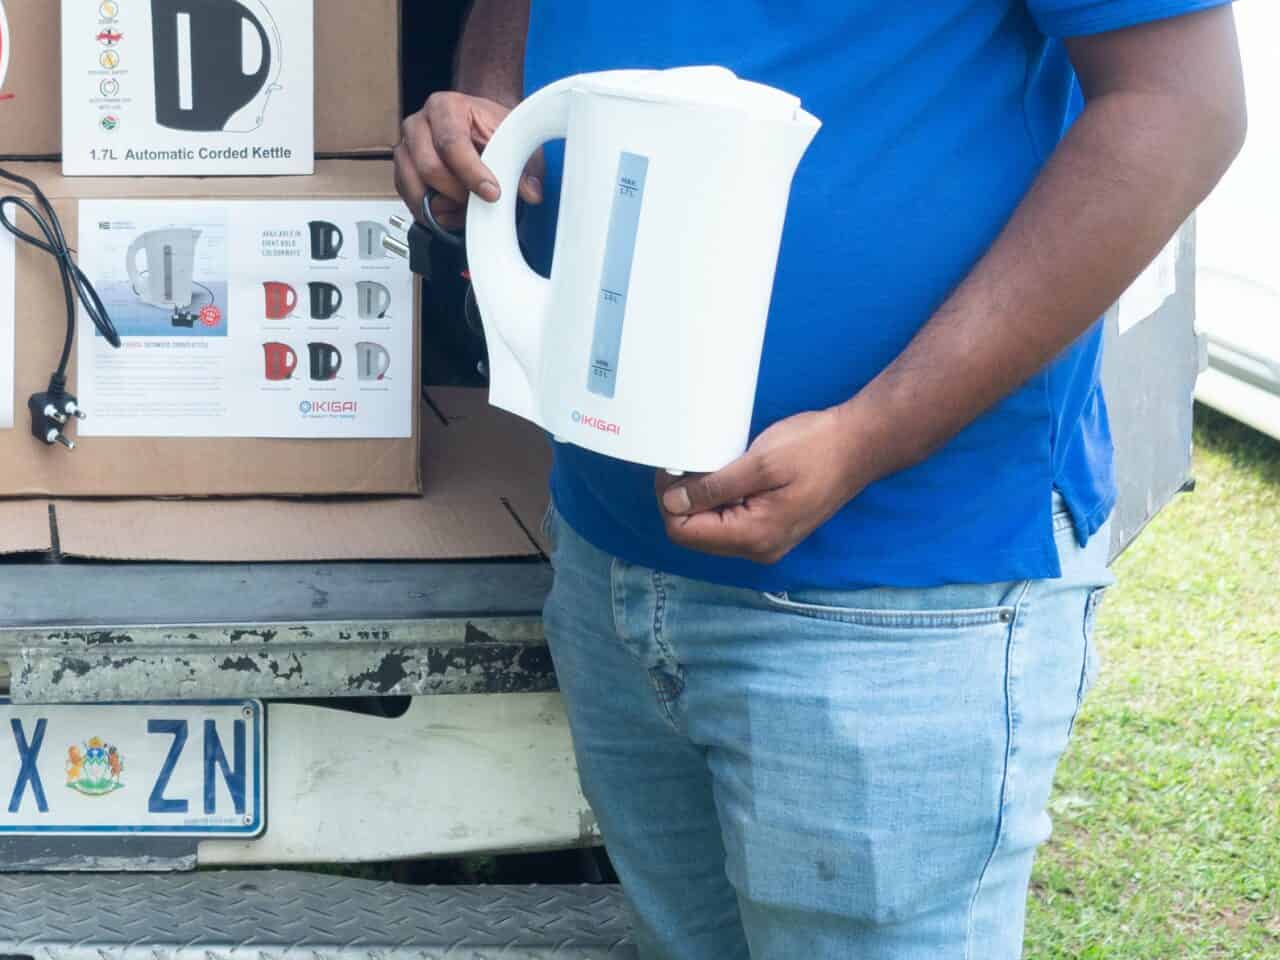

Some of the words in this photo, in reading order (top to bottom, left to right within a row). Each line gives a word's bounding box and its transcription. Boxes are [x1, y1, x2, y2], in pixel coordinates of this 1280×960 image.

[89, 149, 118, 161] 1.7L
[124, 147, 195, 161] Automatic
[198, 146, 248, 160] Corded
[252, 146, 292, 159] Kettle
[312, 401, 357, 412] IKIGAI
[581, 413, 621, 436] IKIGAI
[146, 718, 247, 815] ZN
